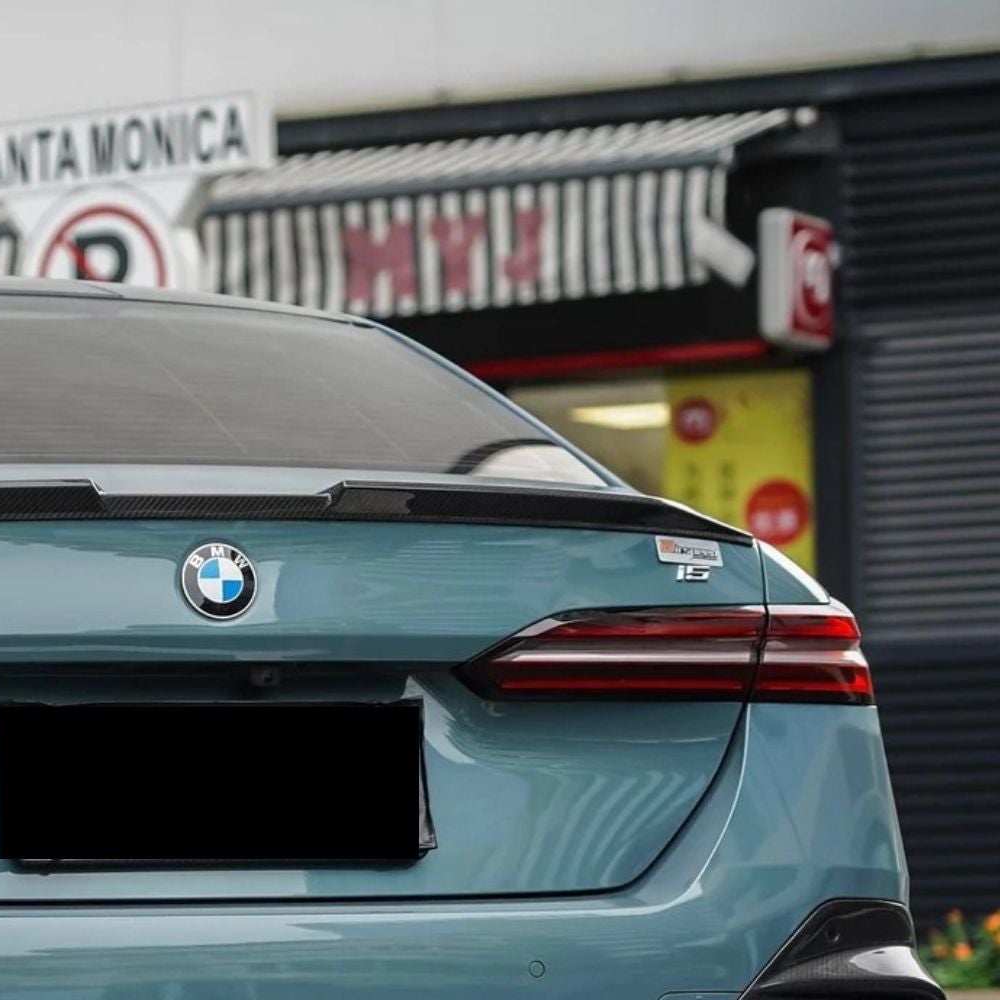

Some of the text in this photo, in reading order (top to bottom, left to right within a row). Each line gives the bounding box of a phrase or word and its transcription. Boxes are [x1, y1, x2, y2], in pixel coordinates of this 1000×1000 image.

[91, 106, 248, 174] MONICA
[75, 231, 129, 283] P
[344, 209, 543, 303] MYJ
[189, 546, 249, 569] BMW
